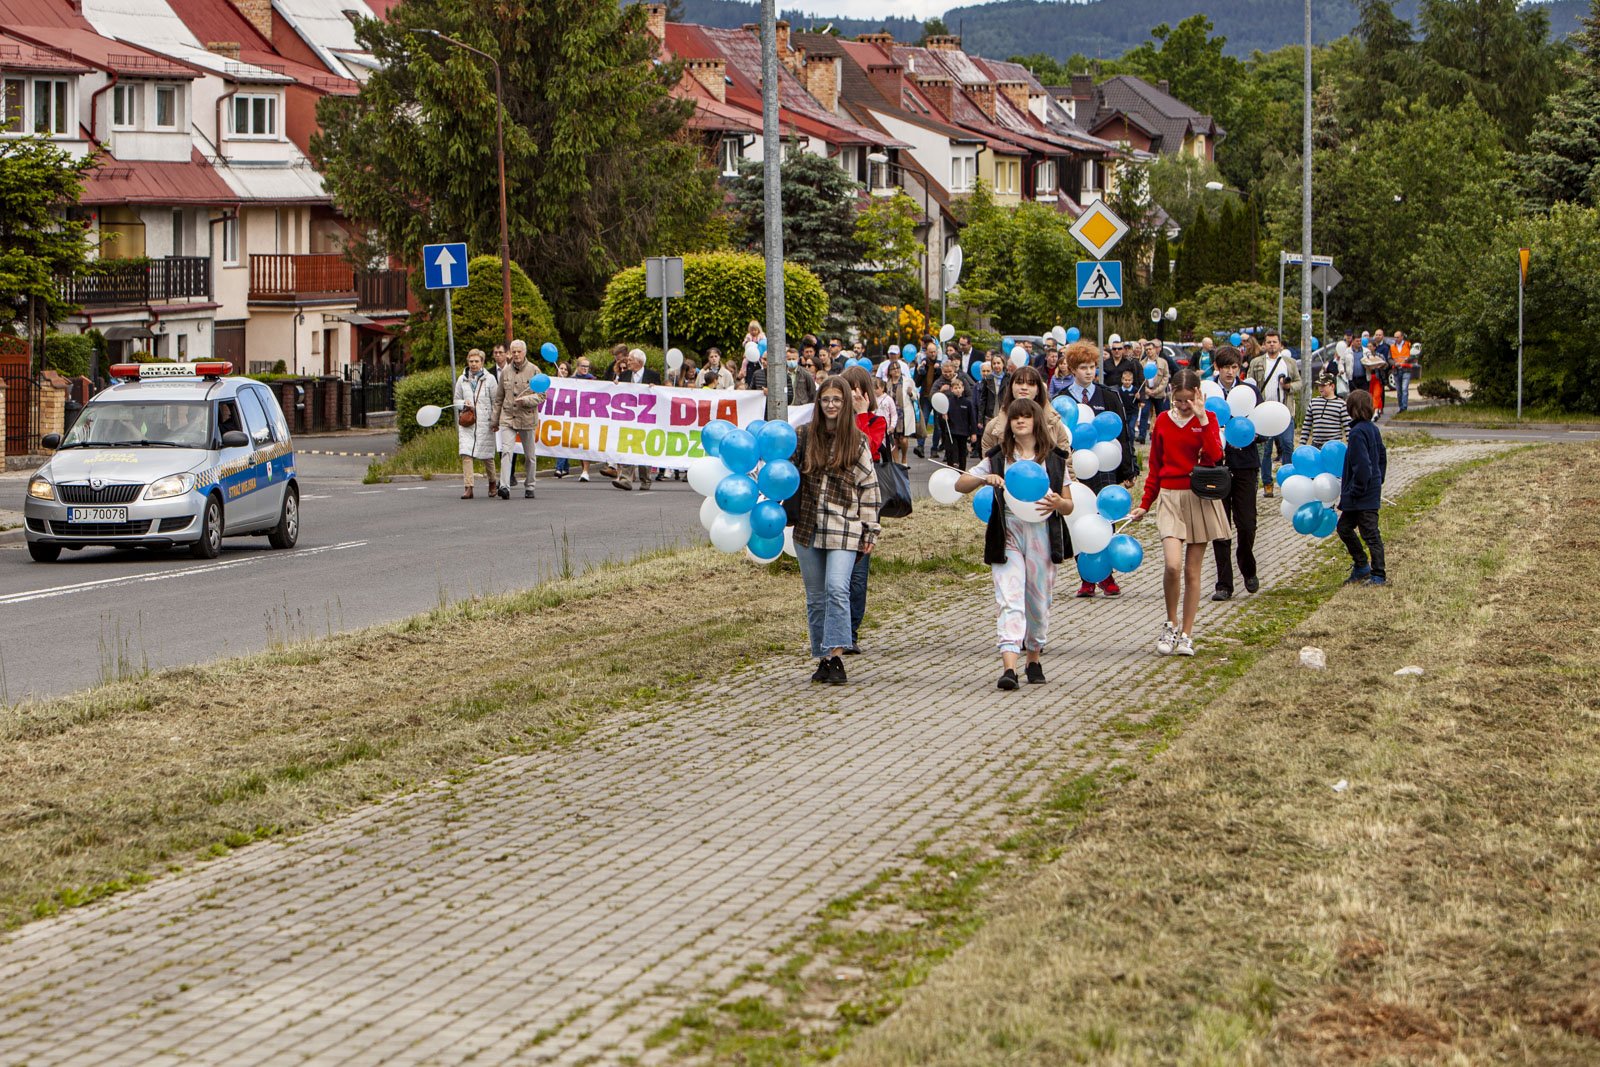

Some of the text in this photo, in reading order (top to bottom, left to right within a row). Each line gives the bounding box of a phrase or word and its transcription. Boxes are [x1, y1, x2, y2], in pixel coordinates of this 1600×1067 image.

[598, 425, 609, 452] I
[74, 508, 125, 520] DJ 70078
